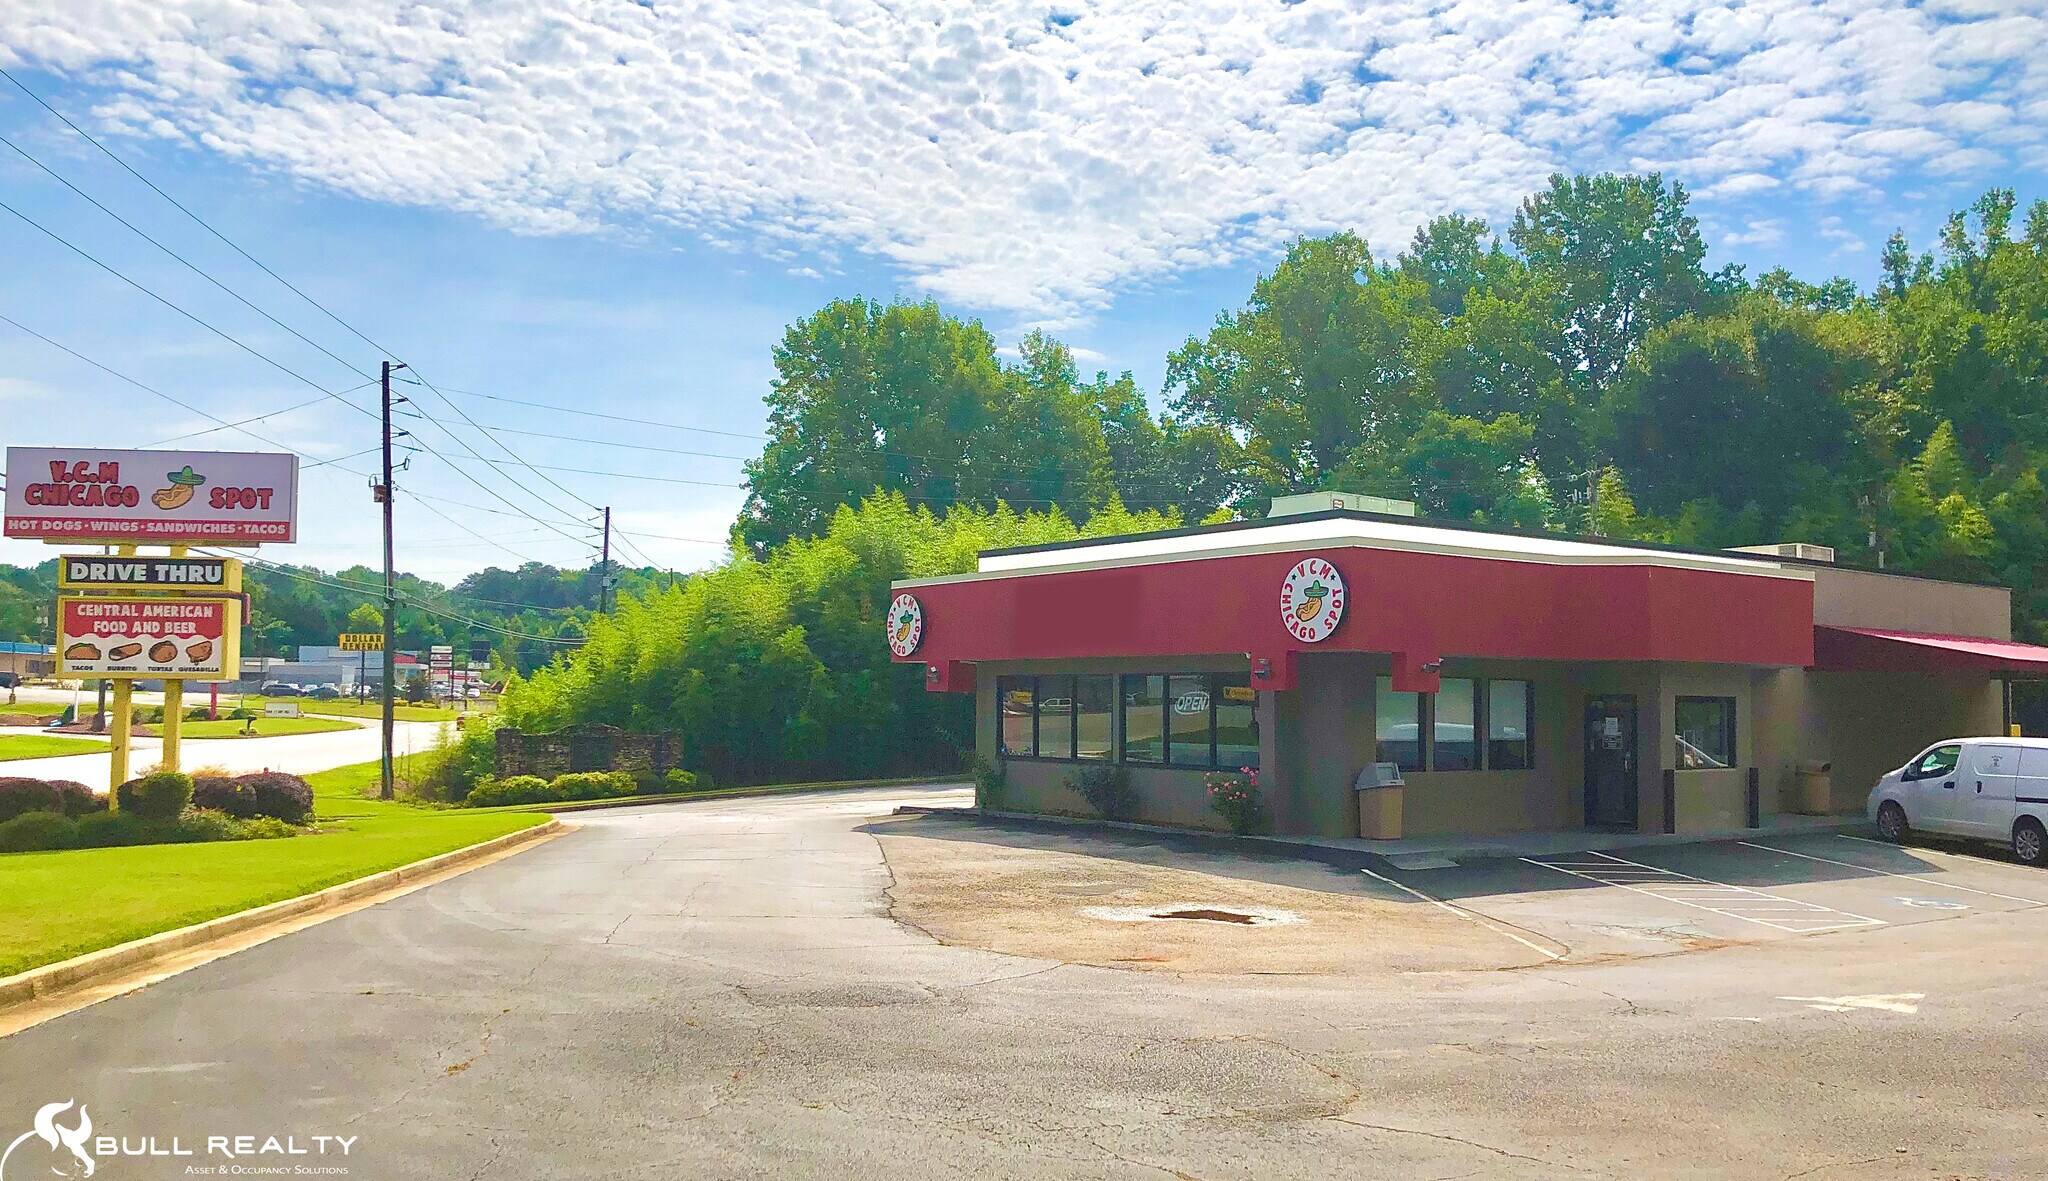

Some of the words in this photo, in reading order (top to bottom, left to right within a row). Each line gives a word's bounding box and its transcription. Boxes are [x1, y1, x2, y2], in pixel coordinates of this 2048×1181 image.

[49, 460, 119, 484] V.C.M
[24, 483, 140, 508] CHICAGO
[208, 487, 274, 510] SPOT
[8, 520, 37, 530] HOT
[42, 520, 82, 531] DOGS
[90, 521, 138, 532] WINGS
[146, 522, 236, 534] SANDWICHES
[243, 524, 286, 535] TACOS
[70, 562, 147, 582] DRIVE
[155, 564, 222, 583] THRU
[1296, 560, 1331, 580] VCM
[896, 595, 915, 609] VCM
[77, 604, 138, 617] CENTRAL
[143, 605, 213, 618] AMERICAN
[1282, 582, 1316, 640] CHICAGO
[1323, 588, 1342, 630] SPOT
[93, 621, 127, 633] FOOD
[132, 621, 160, 634] AND
[164, 622, 196, 634] BEER
[888, 612, 906, 655] CHICAGO
[910, 617, 920, 648] SPOT
[344, 634, 382, 643] DOLLAR
[1177, 696, 1207, 710] OPEN
